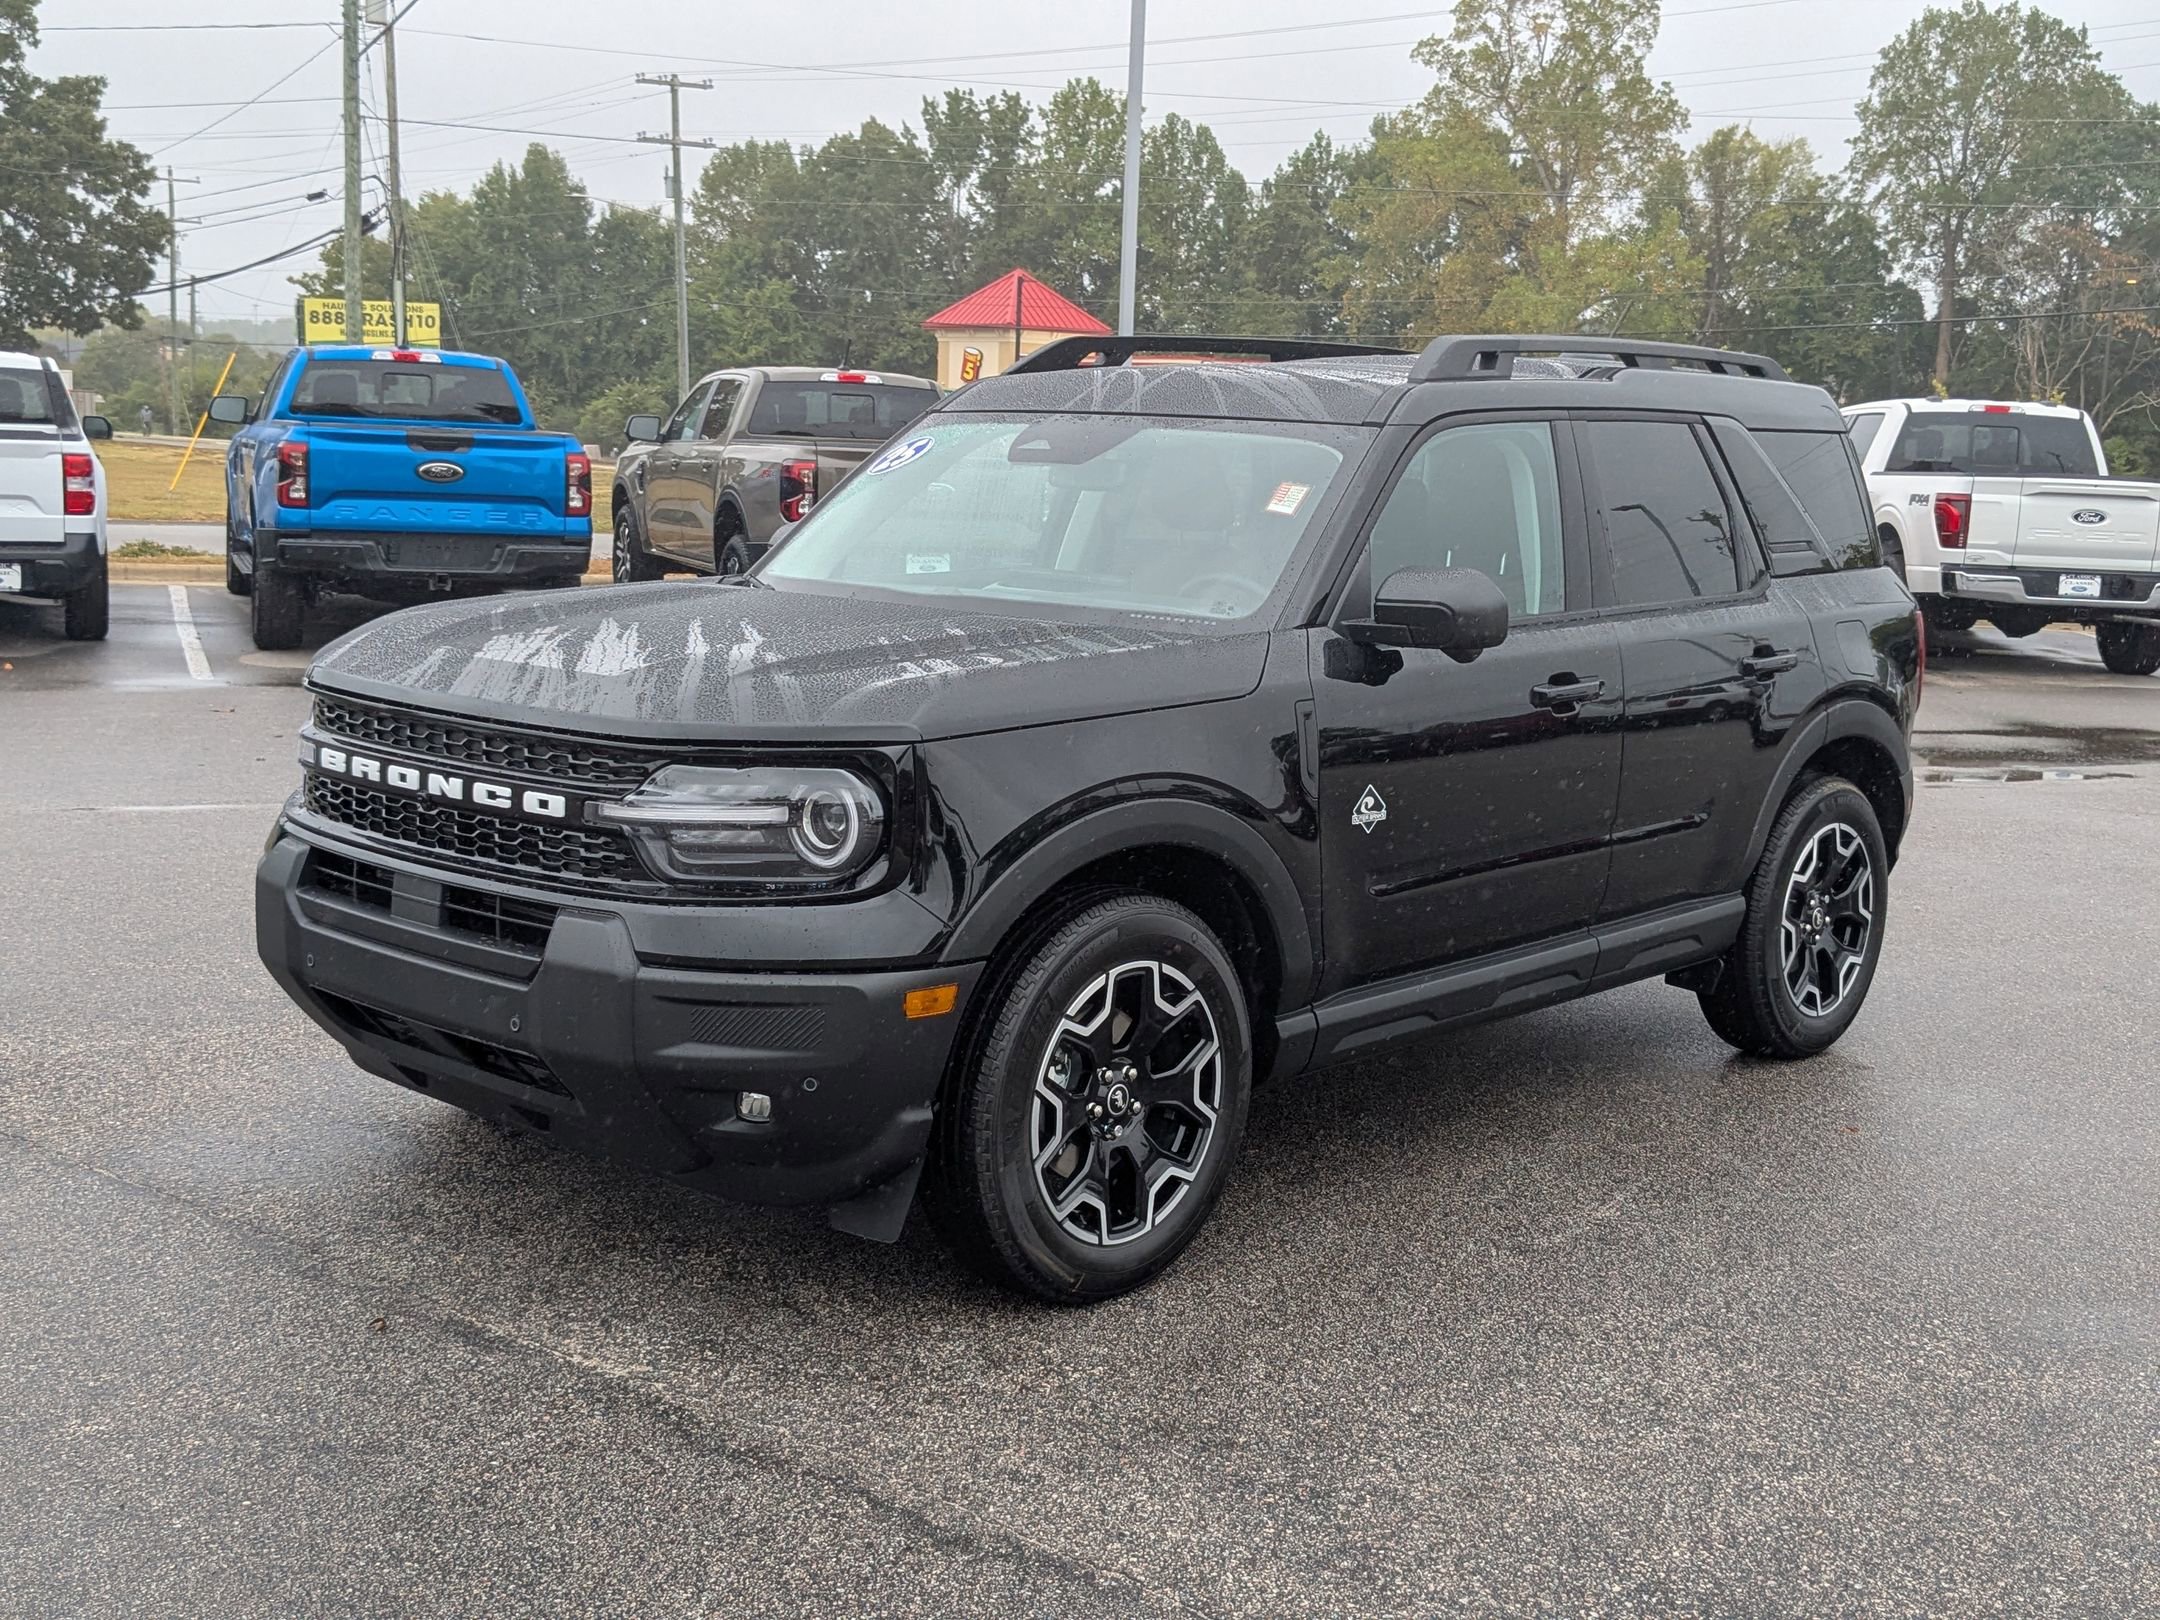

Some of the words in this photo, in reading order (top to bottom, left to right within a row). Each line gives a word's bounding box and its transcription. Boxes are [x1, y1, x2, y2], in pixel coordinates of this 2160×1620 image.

[963, 361, 974, 381] 5
[333, 504, 544, 526] RANGER
[2077, 511, 2101, 523] Ford
[320, 747, 566, 818] BRONCO
